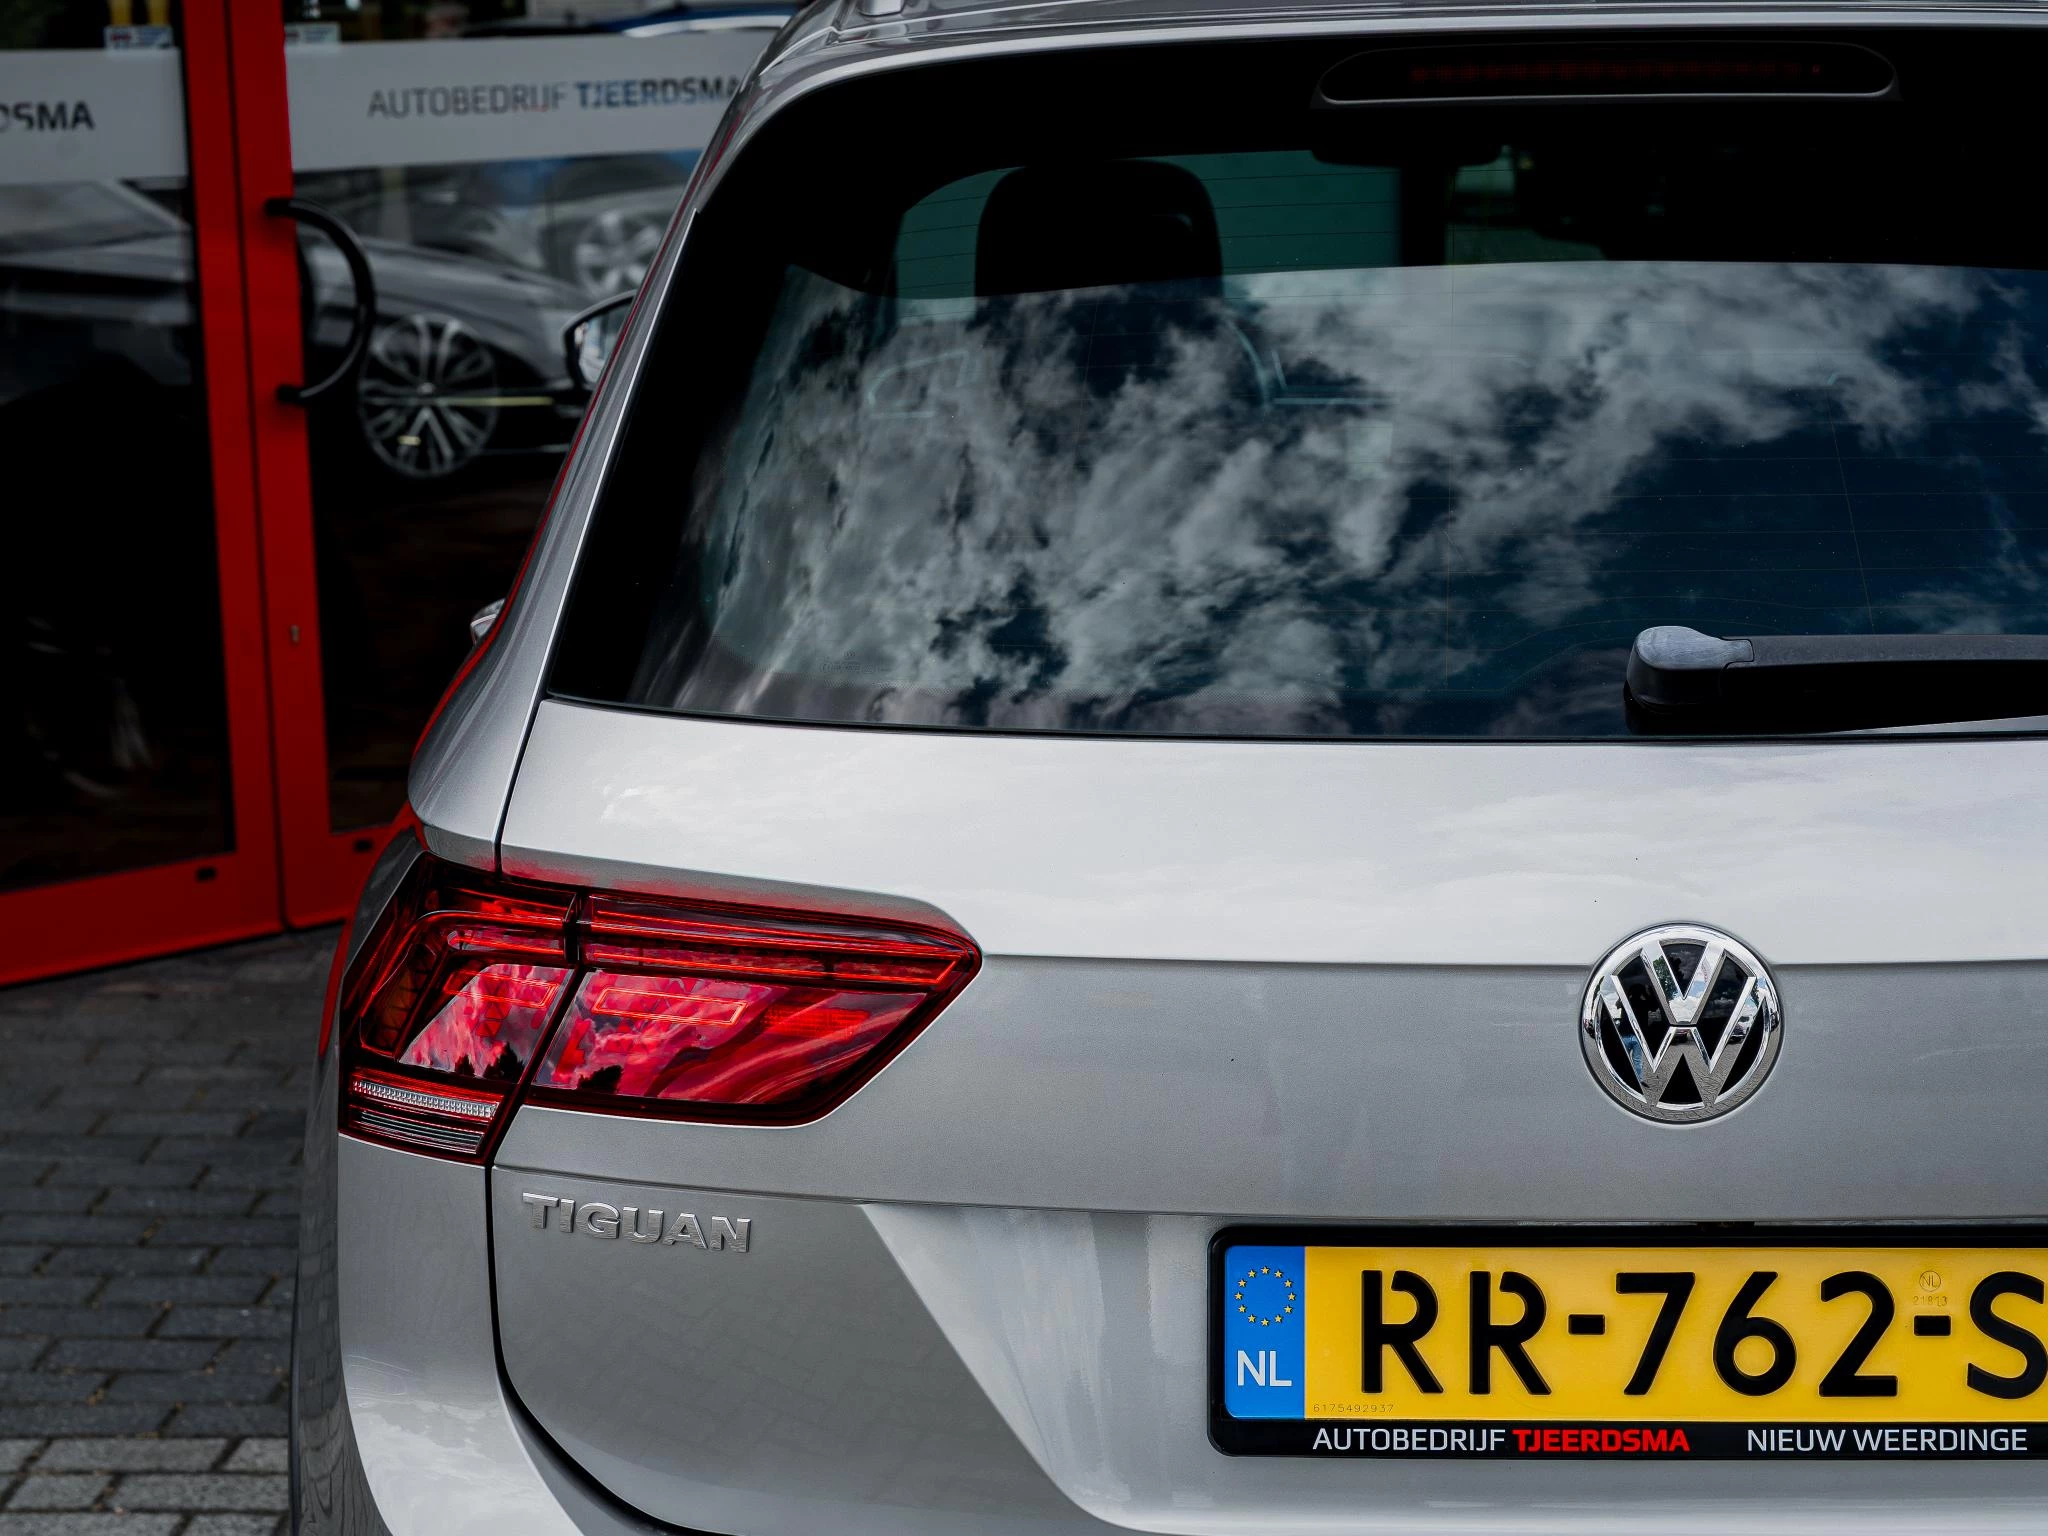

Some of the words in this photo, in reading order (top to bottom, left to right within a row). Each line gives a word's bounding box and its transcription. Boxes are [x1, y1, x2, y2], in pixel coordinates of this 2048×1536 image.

[367, 82, 570, 119] AUTOBEDRIJF
[522, 1192, 750, 1253] TIGUAN
[1361, 1269, 2048, 1400] RR-762-S
[1236, 1350, 1293, 1388] NL
[1313, 1403, 1395, 1413] 6175492937
[1313, 1428, 1506, 1452] AUTOBEDRIJF
[1513, 1428, 1690, 1452] TJEERDSMA
[1747, 1429, 1846, 1452] NIEUW
[1853, 1428, 2028, 1451] WEERDINGE
